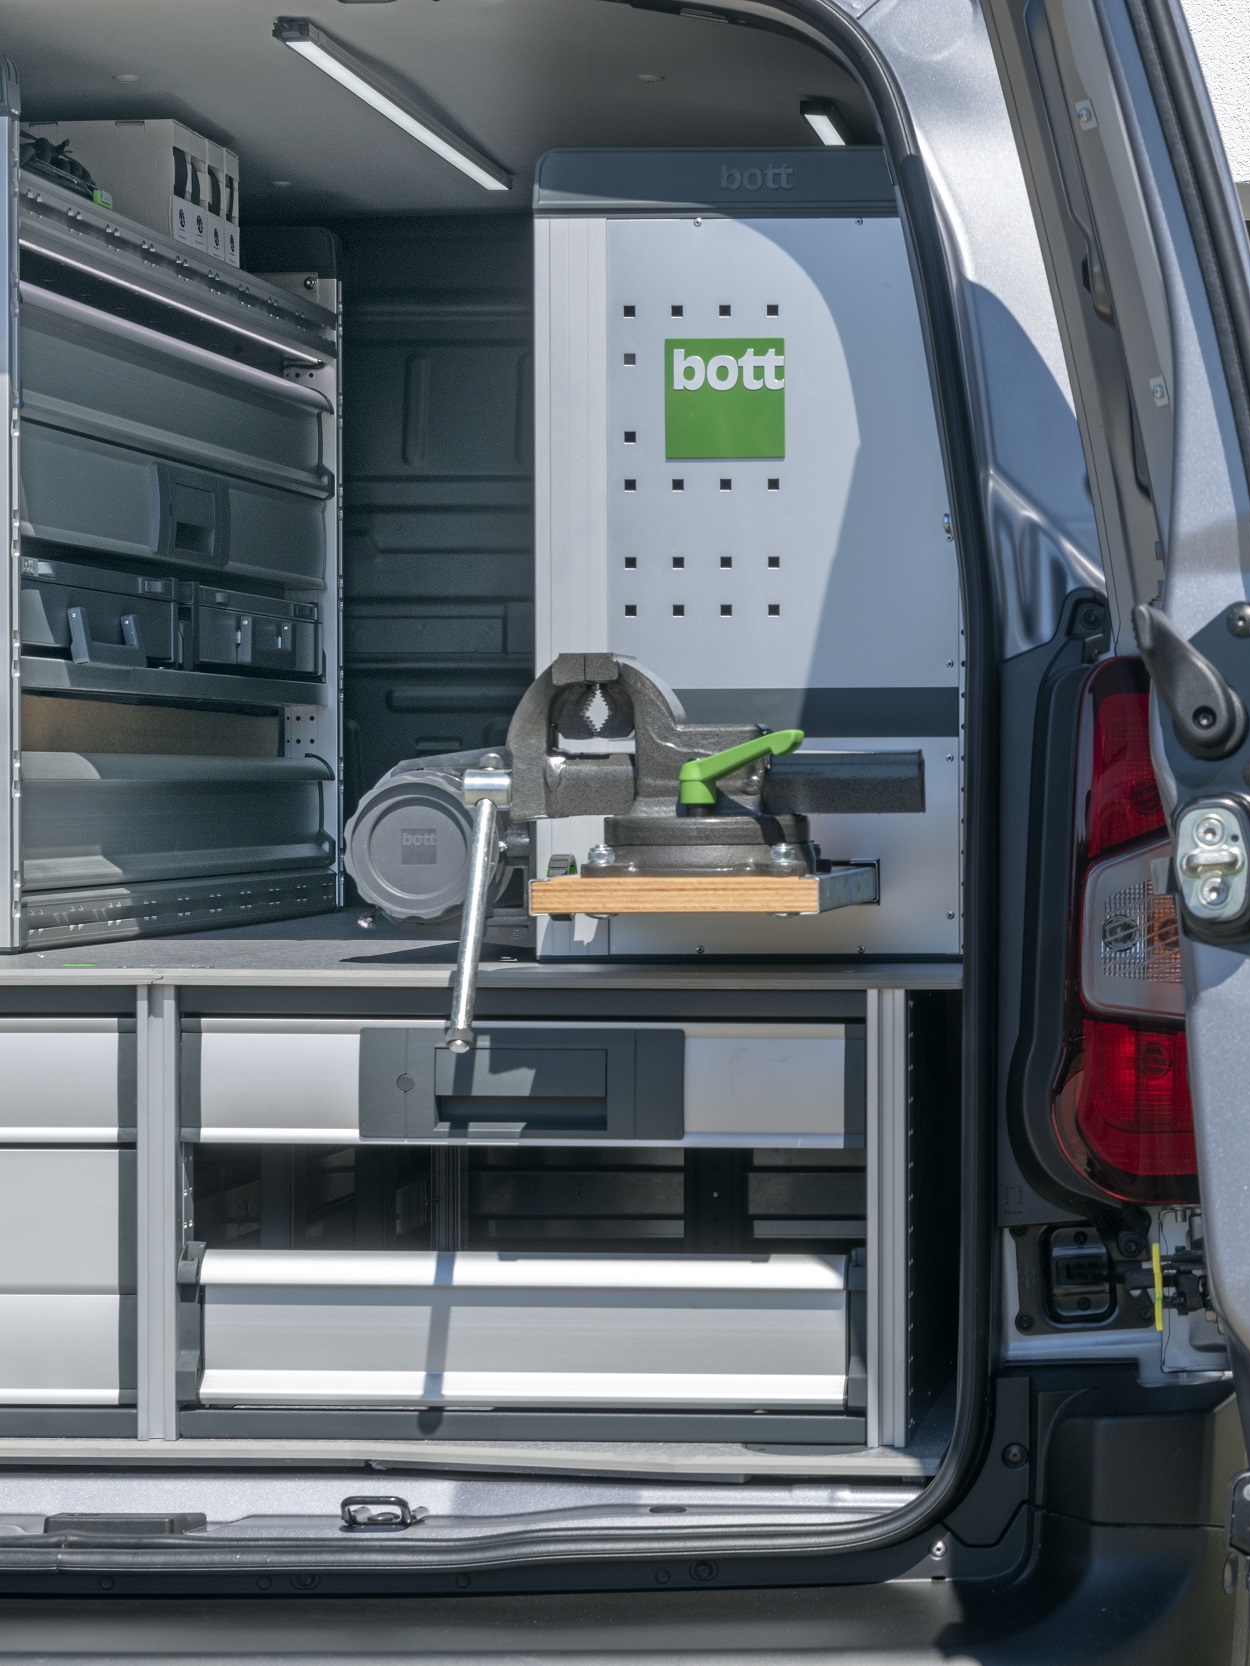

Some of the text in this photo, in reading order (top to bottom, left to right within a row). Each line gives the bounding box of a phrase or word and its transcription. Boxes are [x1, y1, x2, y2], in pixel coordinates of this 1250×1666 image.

[720, 163, 794, 191] bott
[673, 348, 785, 391] bott
[402, 832, 437, 846] bott
